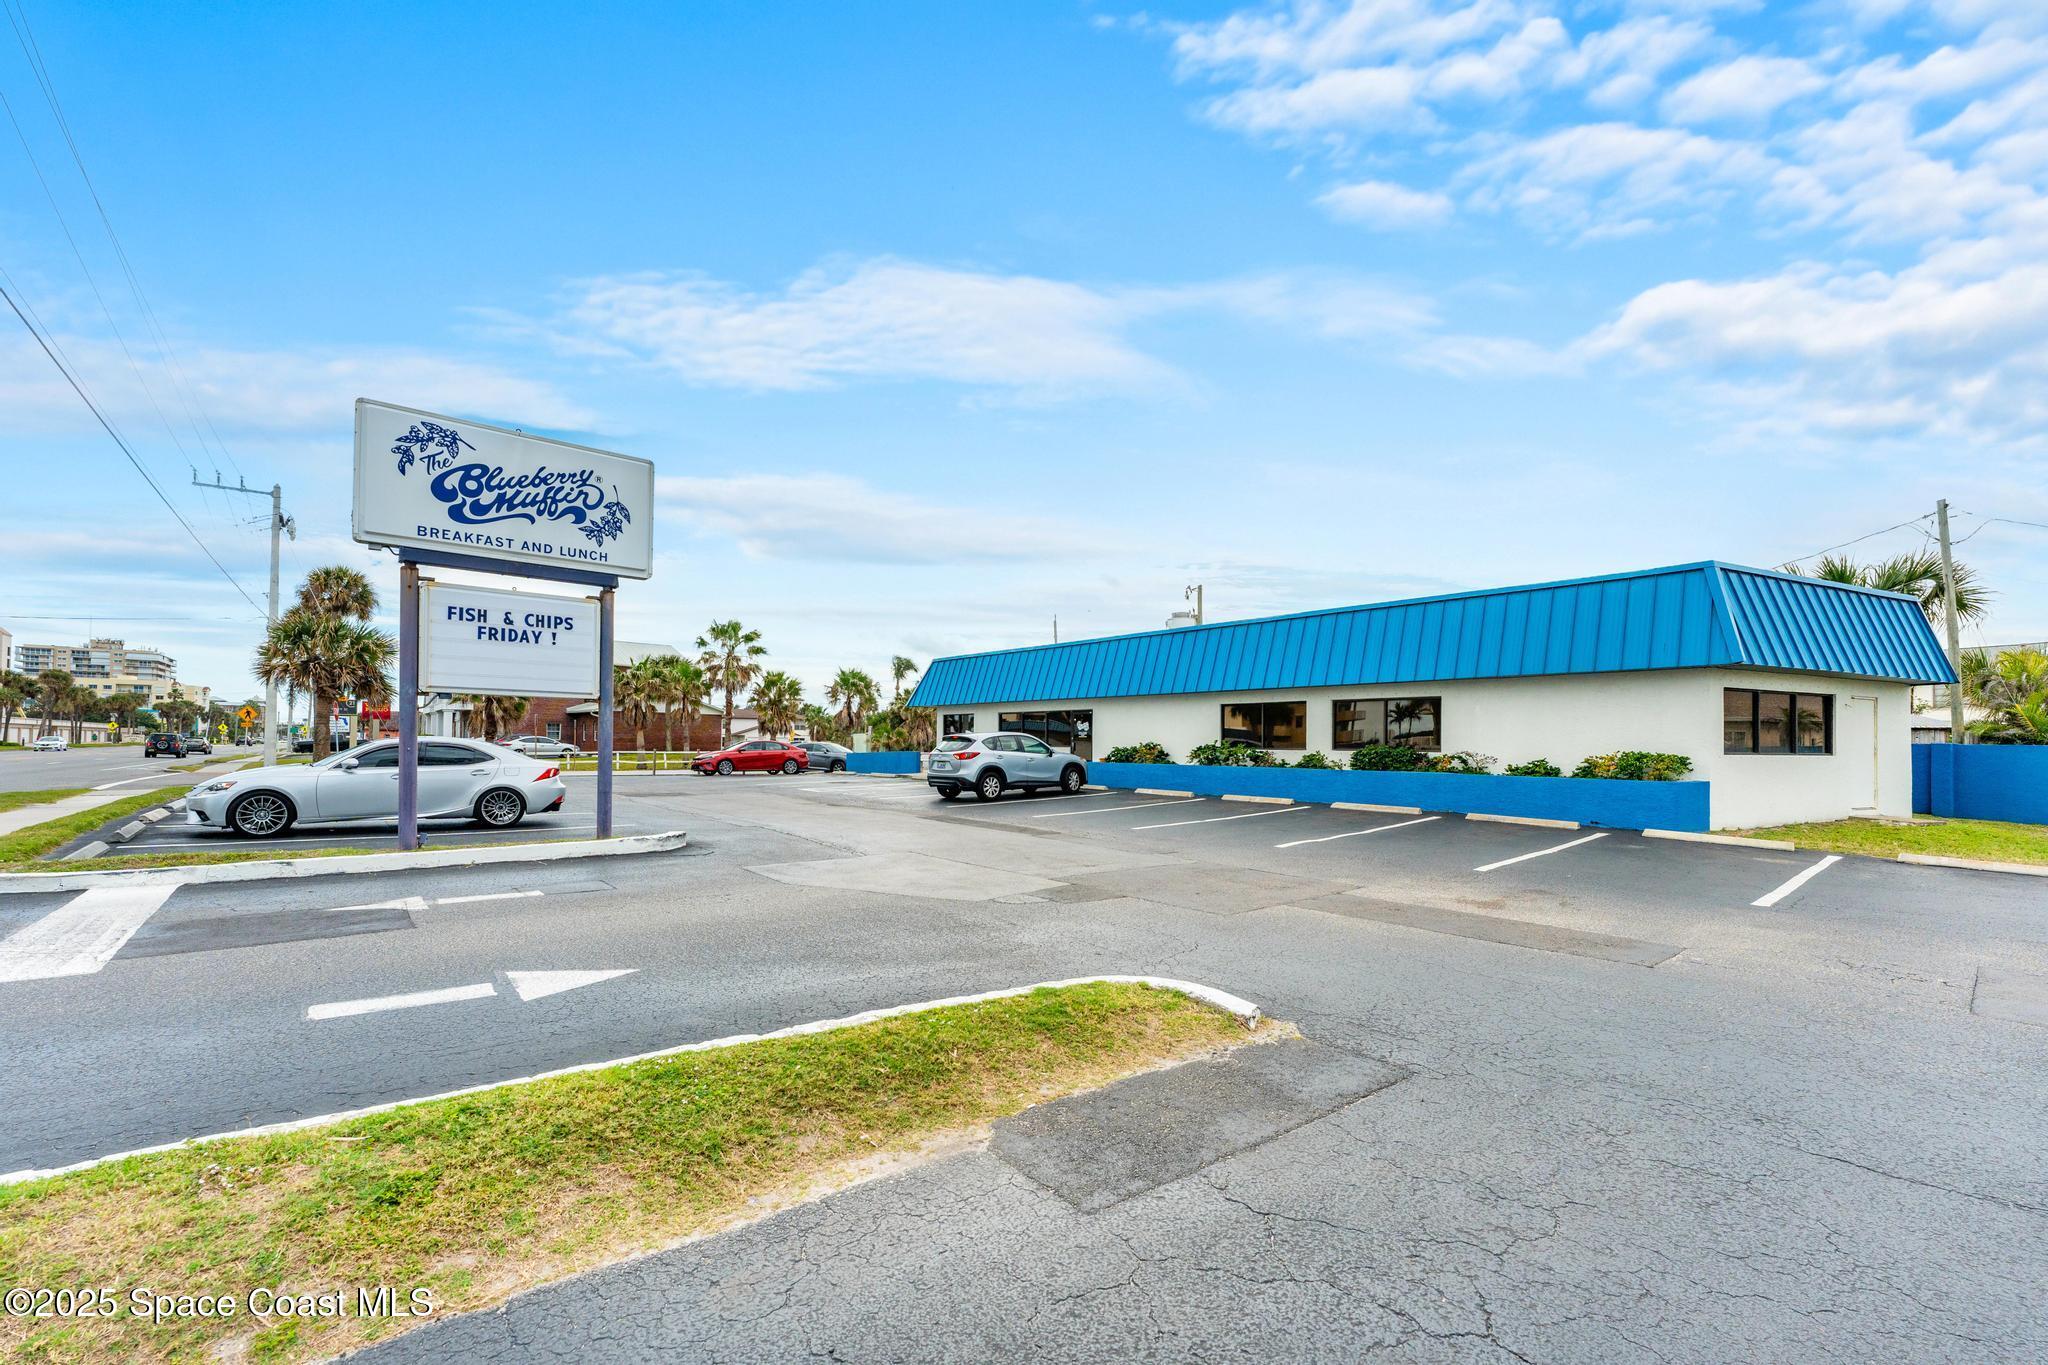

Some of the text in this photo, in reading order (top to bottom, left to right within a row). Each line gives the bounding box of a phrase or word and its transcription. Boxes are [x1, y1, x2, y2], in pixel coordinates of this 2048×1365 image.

[419, 450, 453, 475] The
[430, 463, 594, 503] Blueberry
[469, 483, 605, 520] Muffin
[417, 525, 609, 563] BREAKFAST AND LUNCH
[447, 605, 574, 631] FISH & CHIPS
[477, 626, 543, 645] FRIDAY
